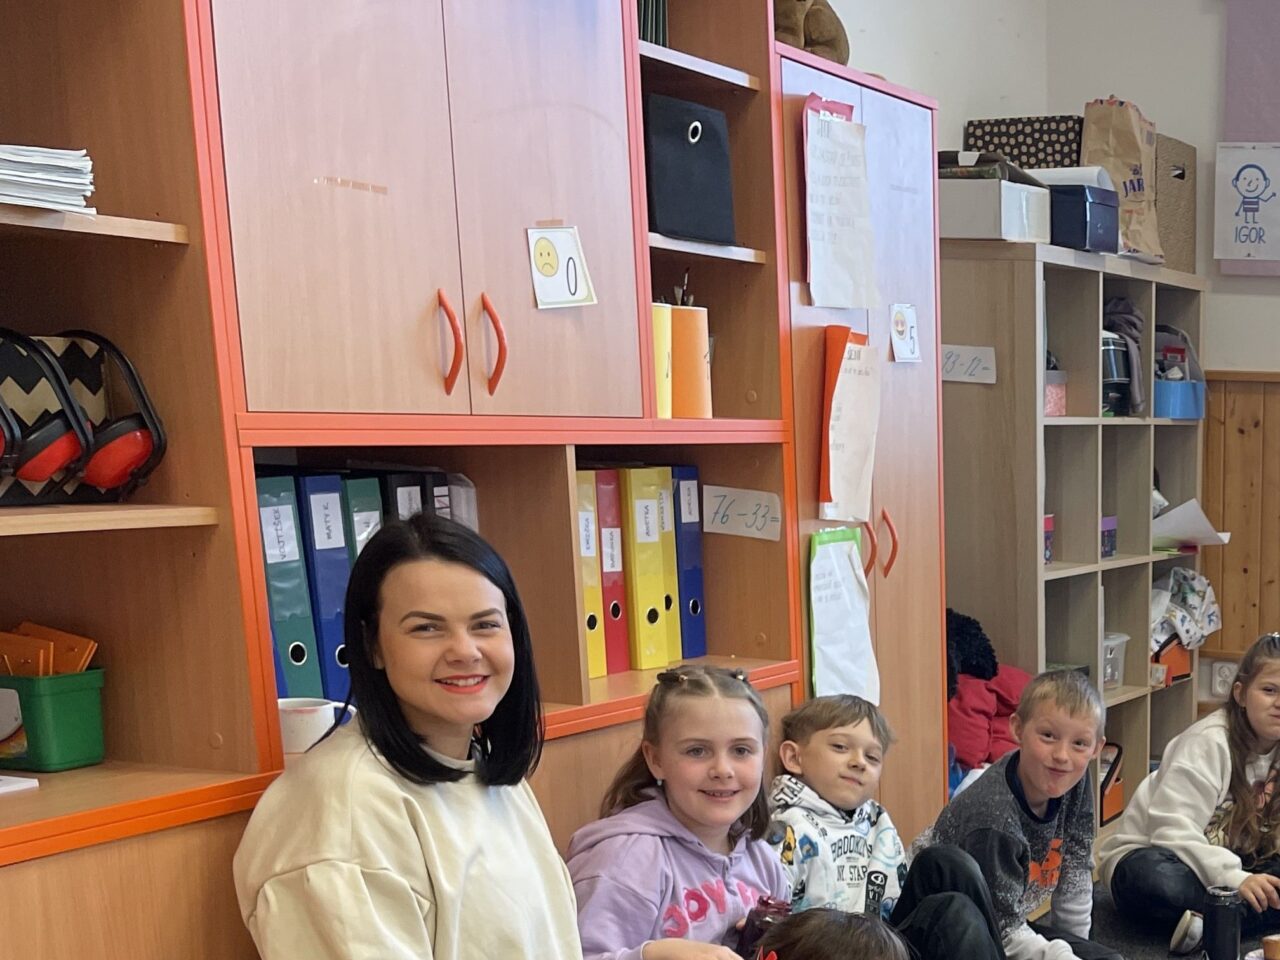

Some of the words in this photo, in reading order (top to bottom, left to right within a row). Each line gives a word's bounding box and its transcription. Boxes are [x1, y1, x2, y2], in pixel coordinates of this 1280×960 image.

[1234, 226, 1266, 245] IGOR
[909, 325, 916, 355] 5
[663, 879, 727, 938] JOY
